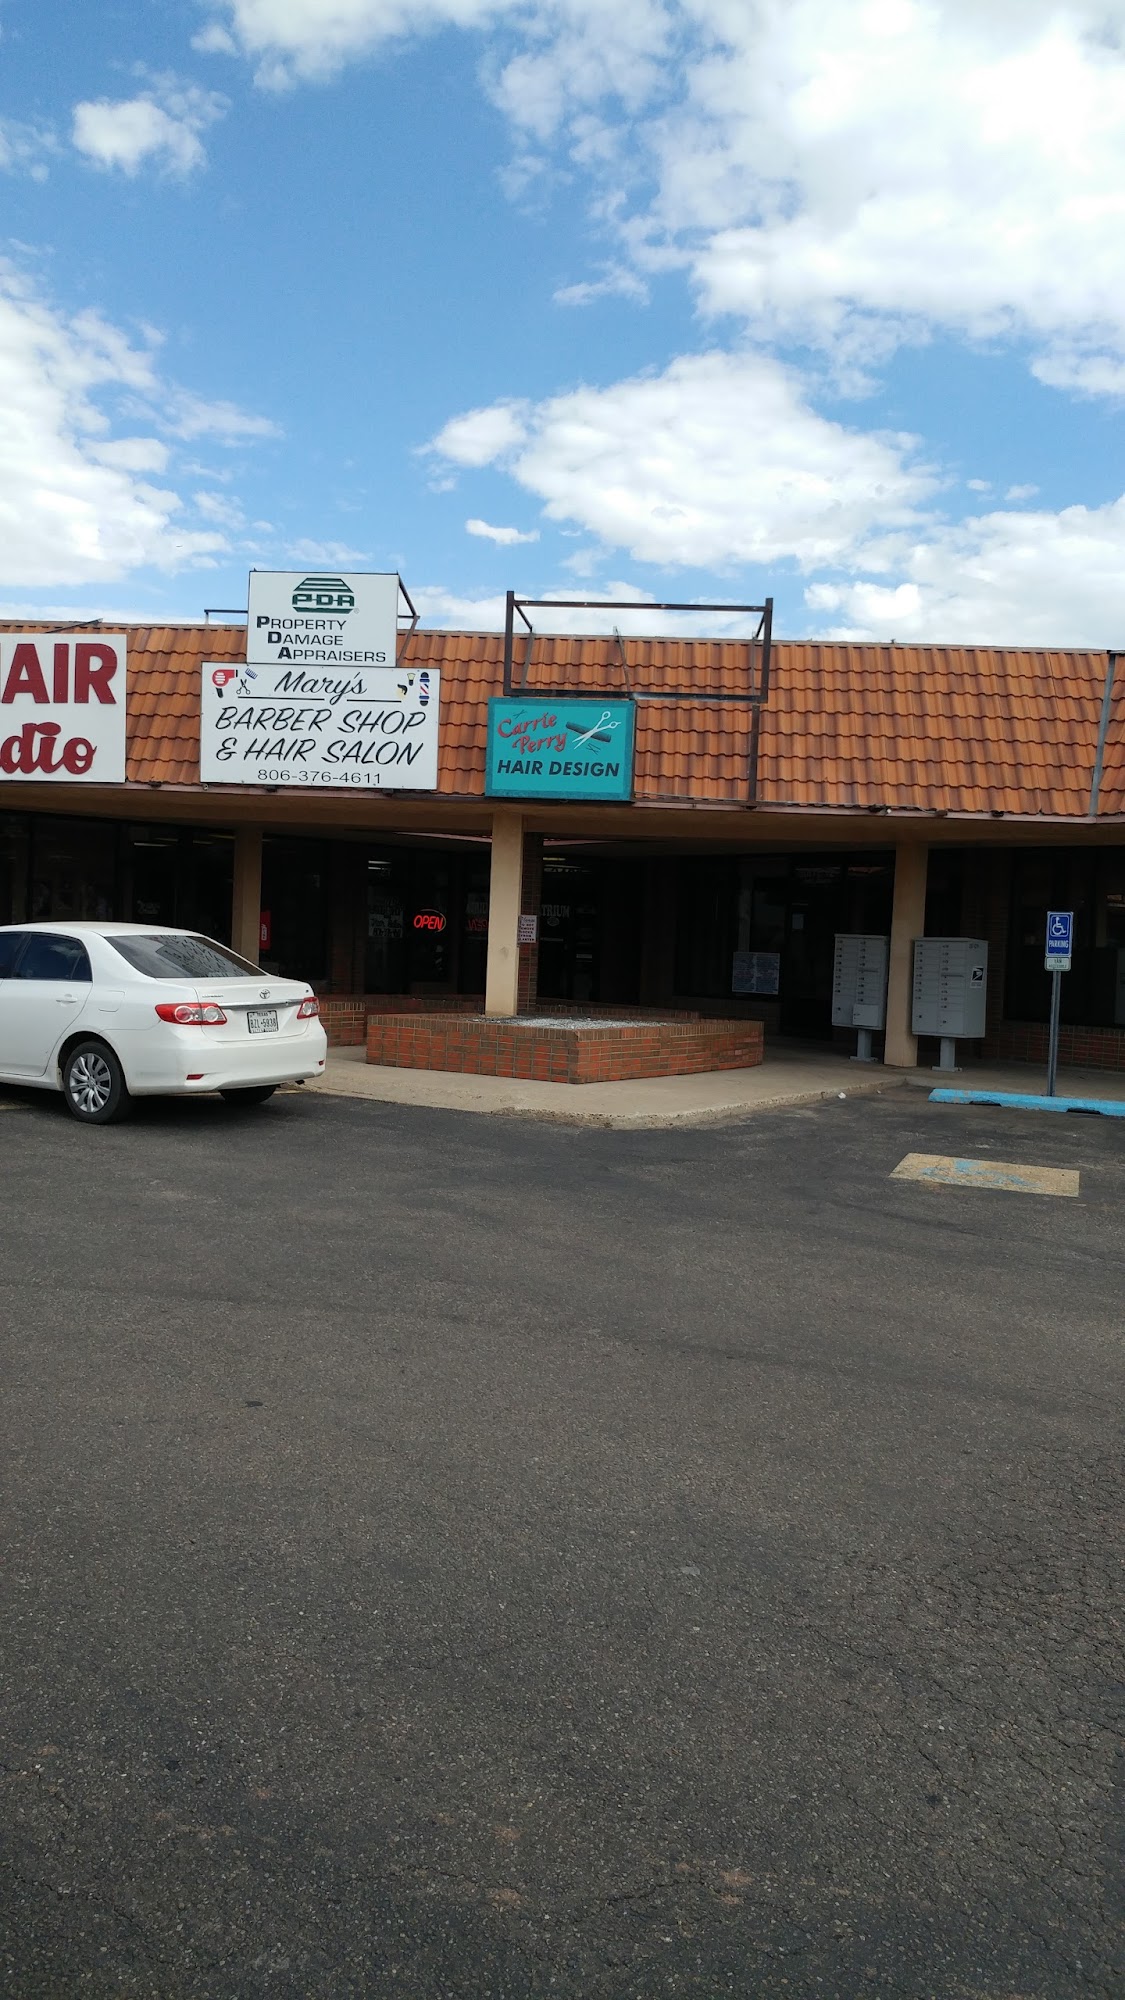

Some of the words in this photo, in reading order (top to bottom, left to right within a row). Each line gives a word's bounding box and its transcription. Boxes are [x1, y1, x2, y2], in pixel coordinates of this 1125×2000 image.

[256, 615, 347, 631] PROPERTY
[267, 631, 344, 646] DAMAGE
[277, 646, 387, 663] APPRAISERS
[0, 643, 118, 705] AIR
[273, 671, 368, 706] Mary's
[215, 706, 333, 732] BARBER
[337, 709, 427, 735] SHOP
[497, 711, 558, 739] Carrie
[215, 736, 238, 761] &
[243, 737, 317, 762] HAIR
[321, 739, 424, 766] SALON
[512, 732, 568, 755] Perry
[257, 768, 382, 785] 806-376-4611
[497, 759, 544, 776] HAIR
[548, 760, 620, 777] DESIGN
[413, 914, 444, 931] OPEN
[1048, 939, 1069, 949] PARKING
